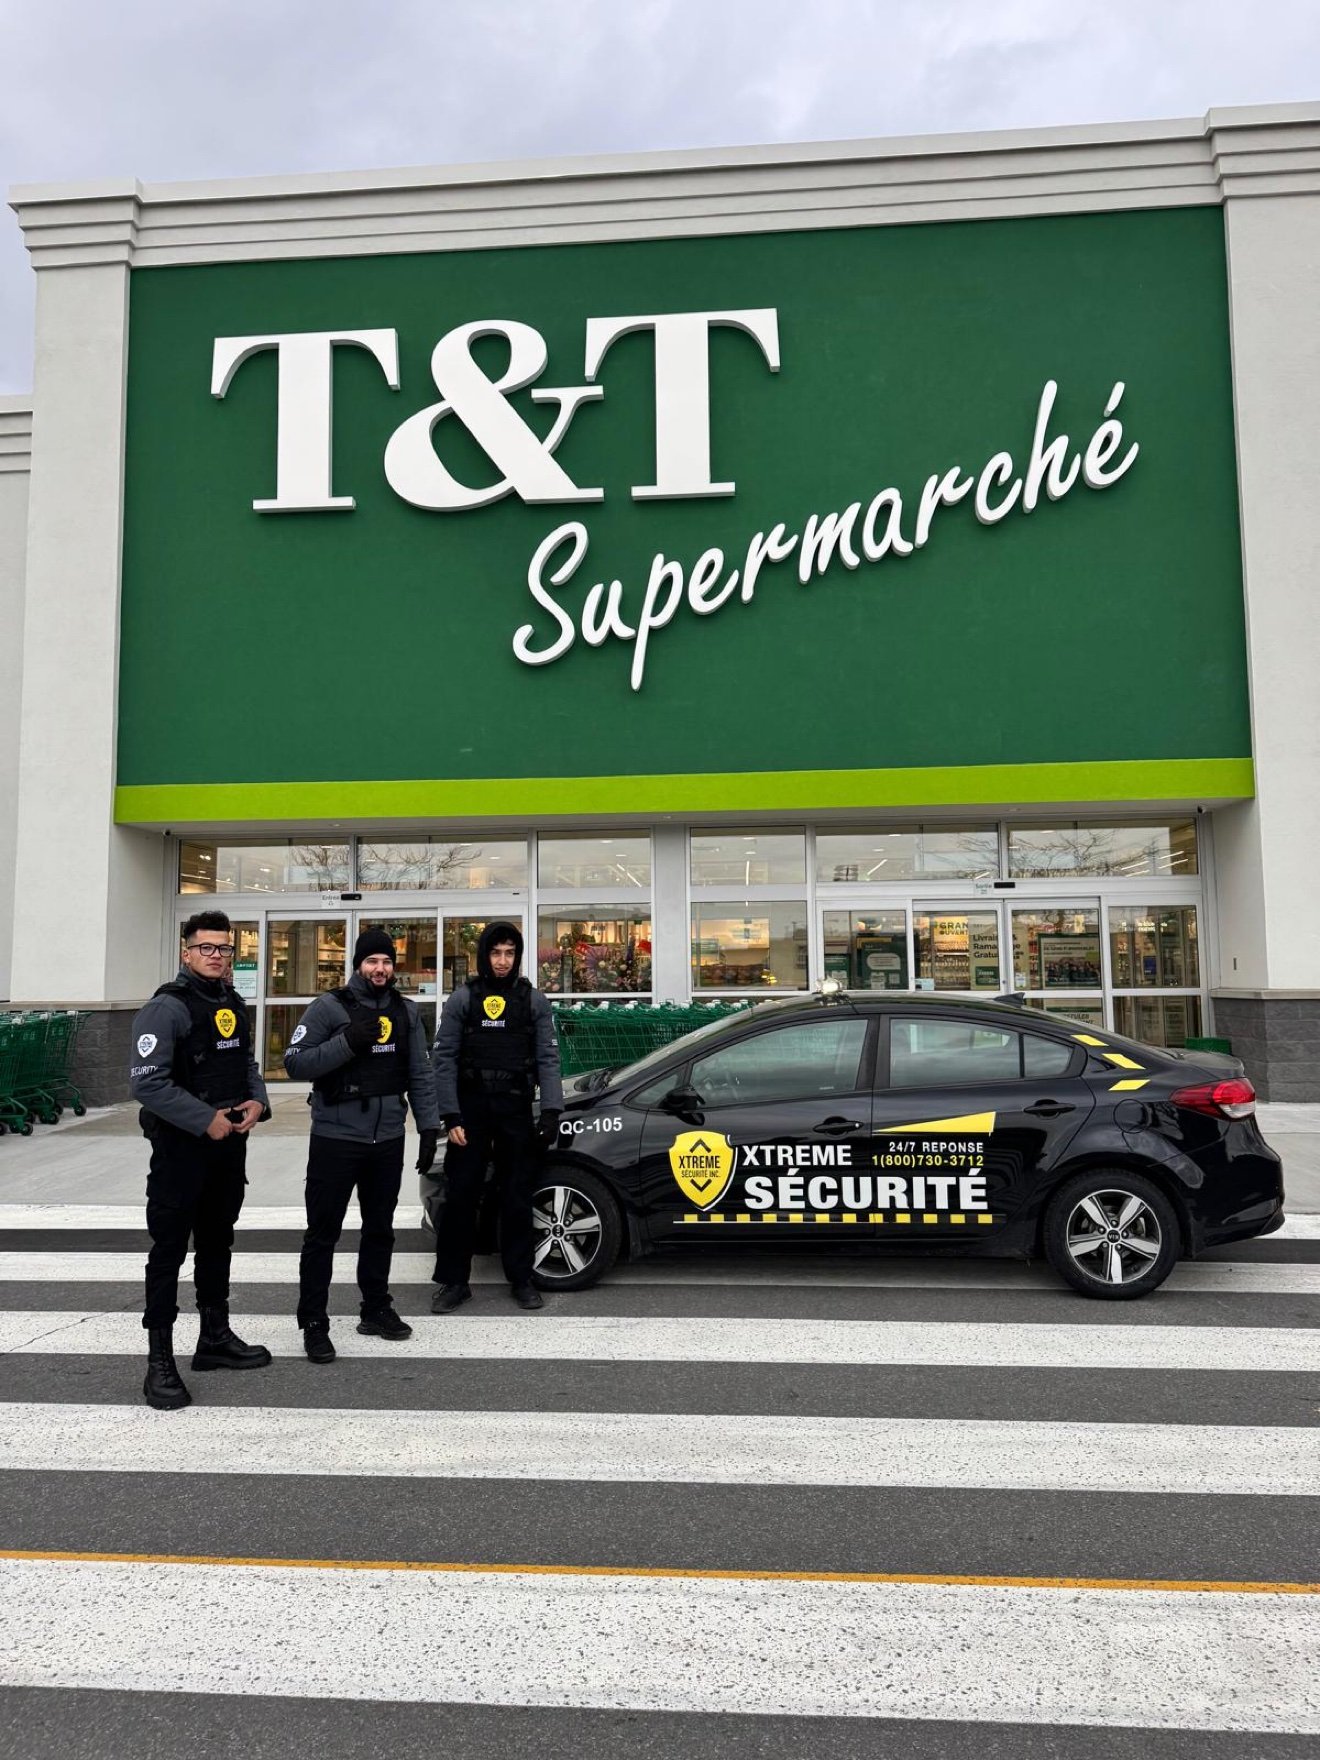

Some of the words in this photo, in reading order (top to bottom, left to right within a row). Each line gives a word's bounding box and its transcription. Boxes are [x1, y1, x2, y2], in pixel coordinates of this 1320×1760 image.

[211, 308, 780, 513] T&T
[512, 380, 1139, 691] Supermarché
[559, 1117, 623, 1135] QC-105
[742, 1145, 852, 1167] XTREME
[889, 1142, 916, 1153] 24/7
[922, 1141, 984, 1153] REPONSE
[678, 1155, 721, 1169] XTREME
[872, 1154, 985, 1169] 1(800)730-3712
[681, 1169, 707, 1178] SÉCURITÉ
[709, 1170, 721, 1178] INC.
[744, 1168, 988, 1210] SÉCURITÉ
